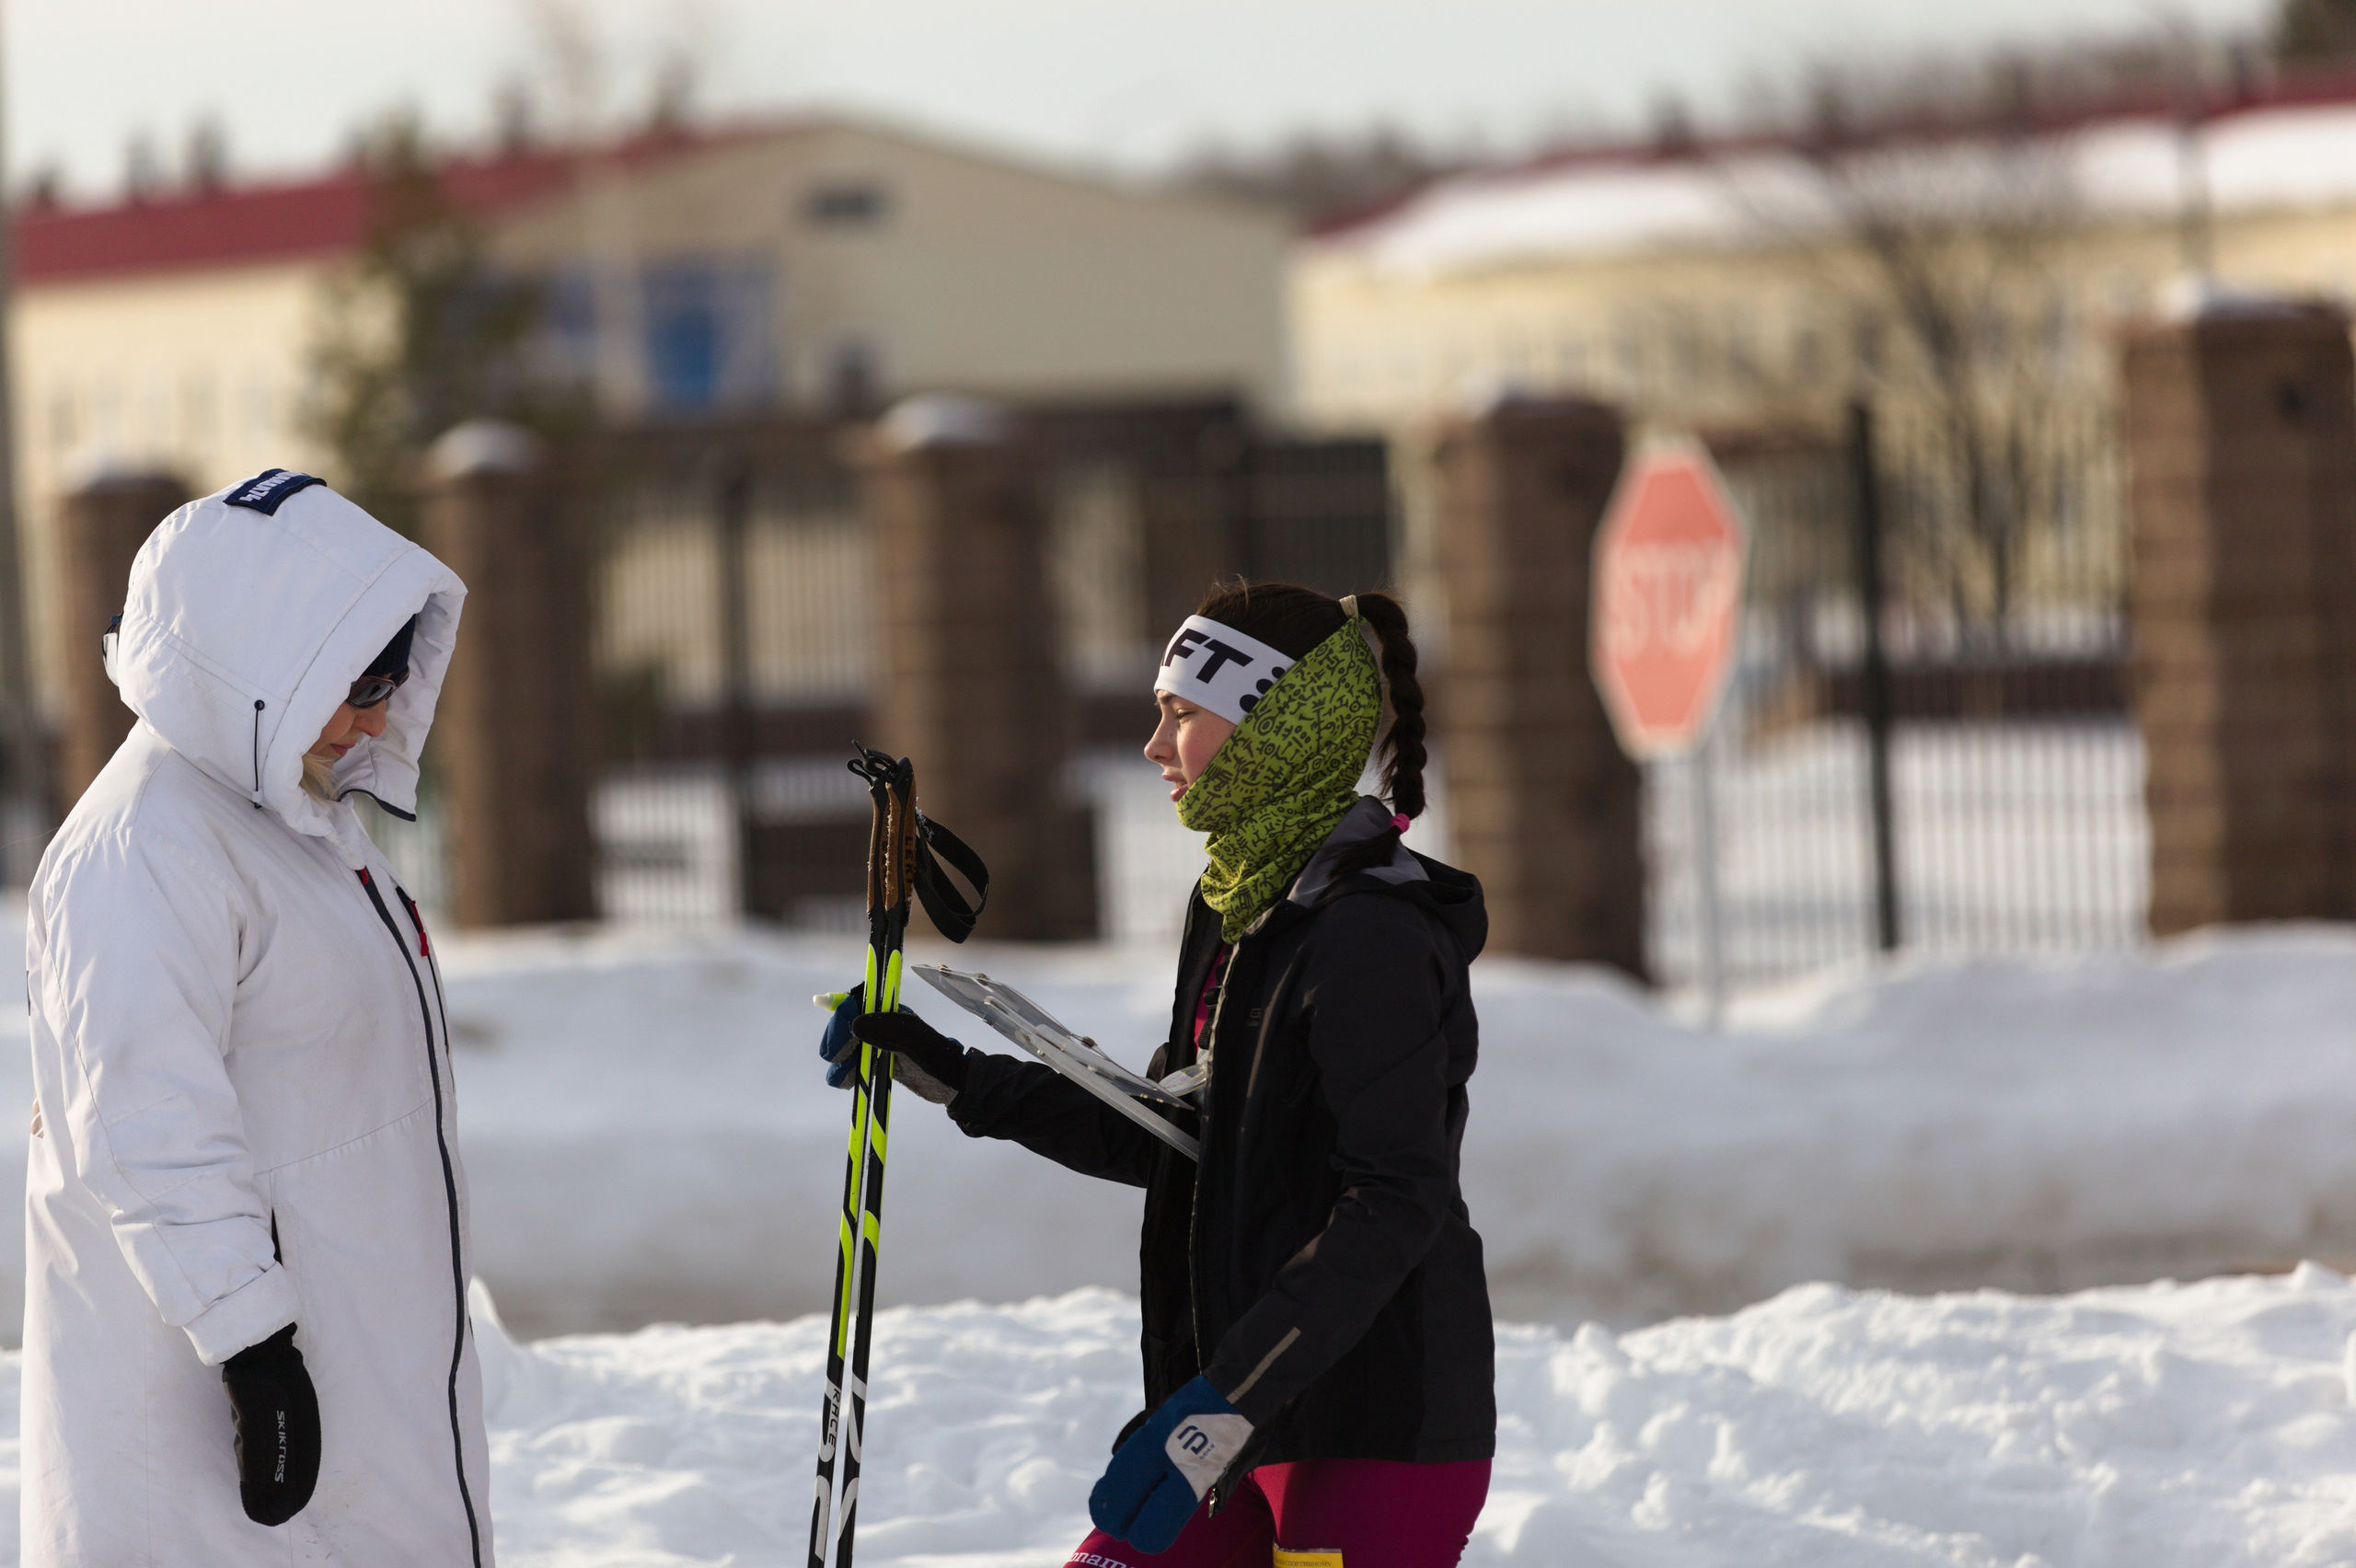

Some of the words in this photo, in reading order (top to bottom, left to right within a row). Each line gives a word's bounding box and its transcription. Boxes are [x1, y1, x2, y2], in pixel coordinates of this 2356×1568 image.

[1603, 539, 1736, 658] STOP
[1161, 628, 1254, 684] FT
[905, 836, 913, 883] LEKI
[828, 1388, 841, 1447] RACE
[1068, 1552, 1137, 1568] onam
